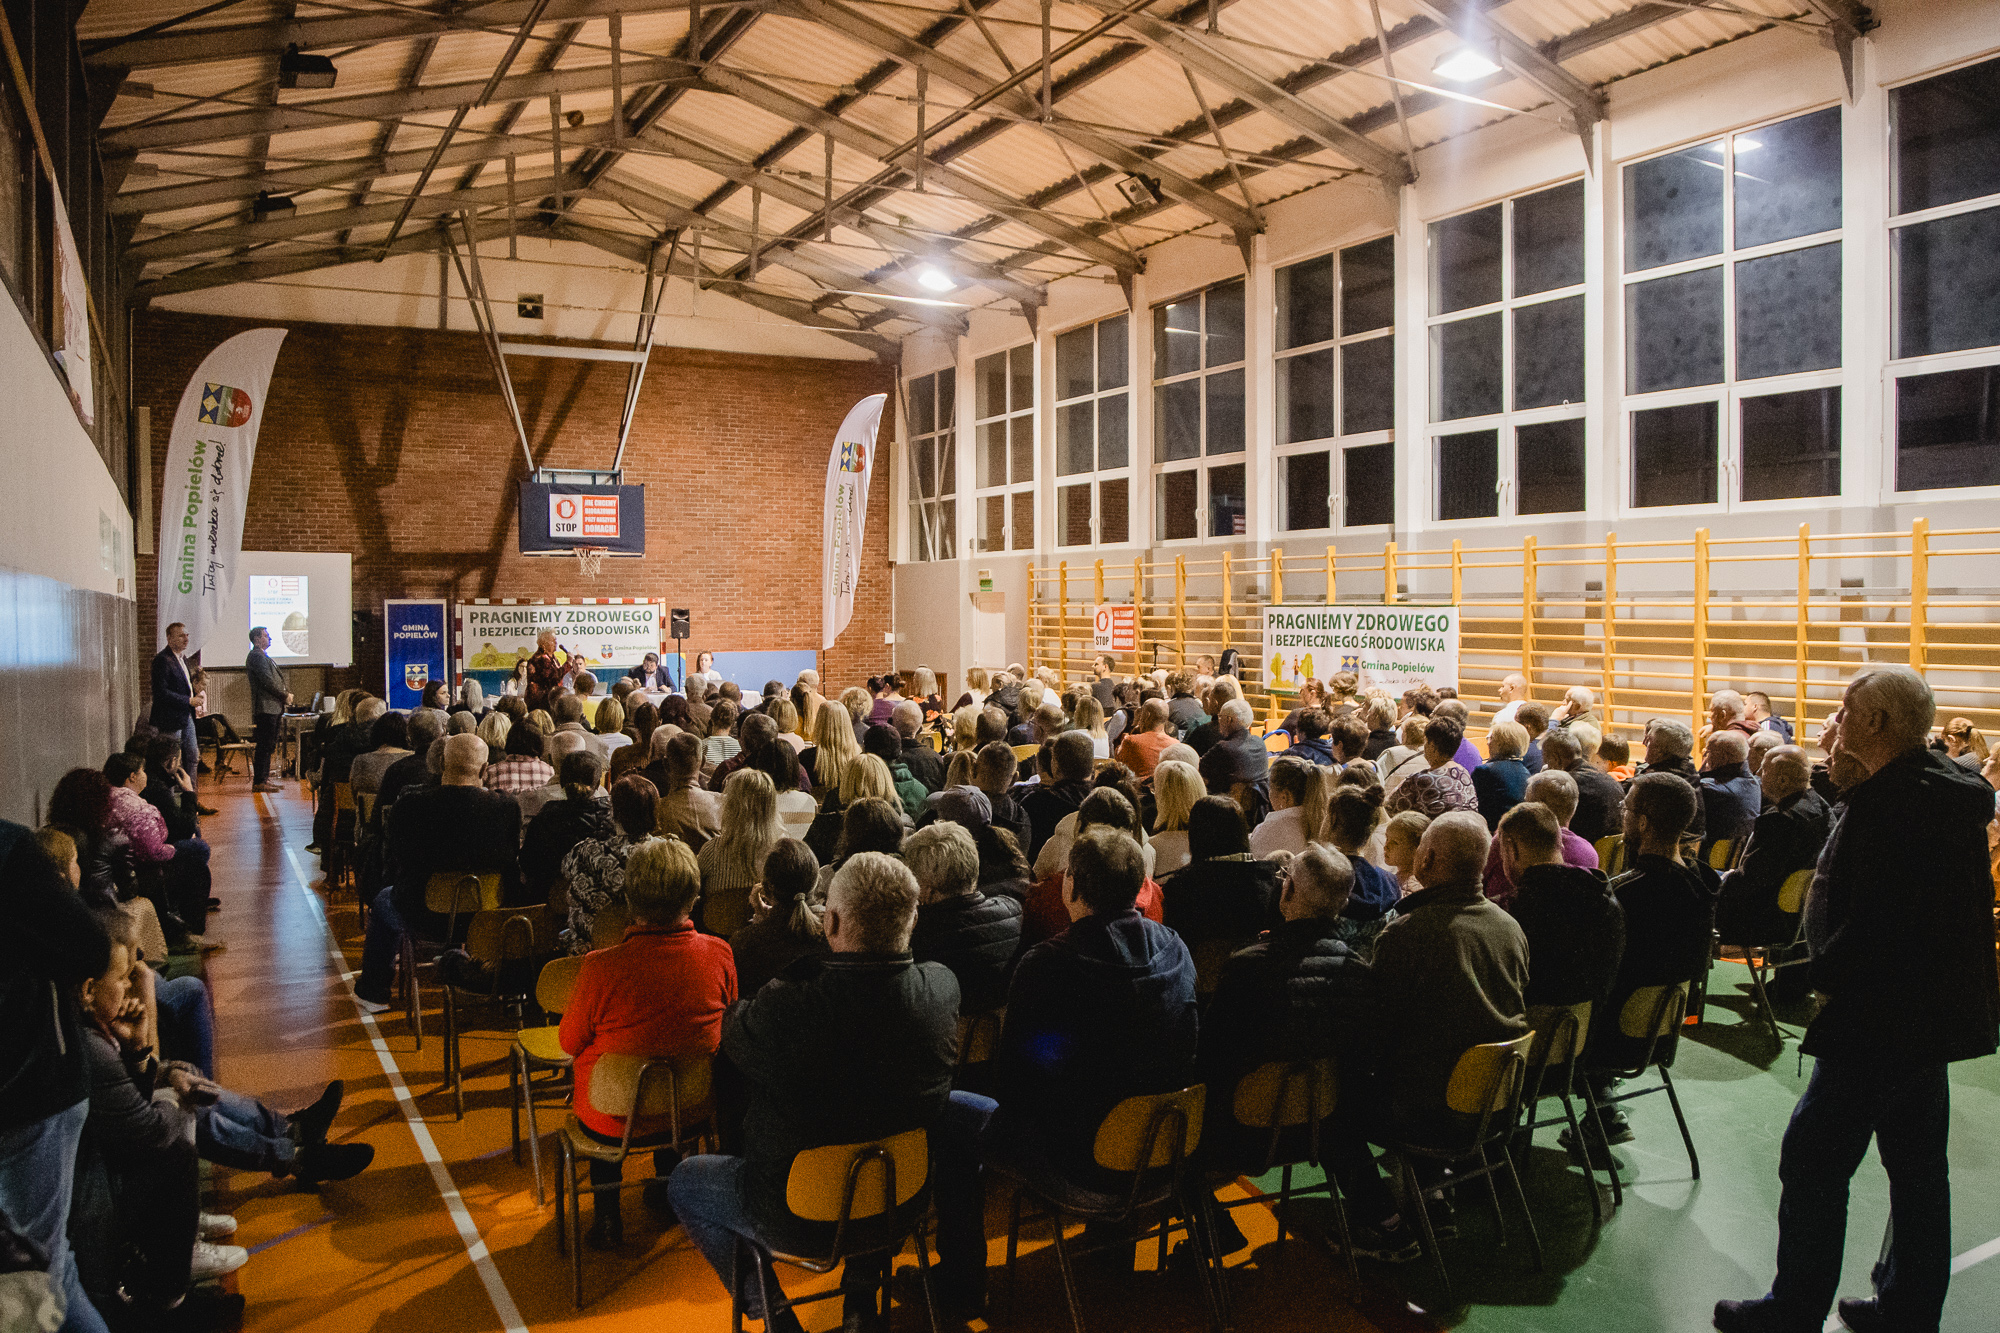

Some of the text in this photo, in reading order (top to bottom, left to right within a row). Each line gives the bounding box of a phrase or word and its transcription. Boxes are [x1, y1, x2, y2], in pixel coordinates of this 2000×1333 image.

[178, 440, 207, 594] Gmina Popielów
[555, 522, 577, 532] STOP
[202, 559, 224, 596] Tutaj
[470, 610, 653, 624] PRAGNIEMY ZDROWEGO
[1268, 613, 1450, 632] PRAGNIEMY ZDROWEGO
[393, 631, 438, 639] POPIELÓW
[473, 627, 477, 637] I
[572, 624, 650, 635] ŚRODOWISKA
[1095, 636, 1110, 645] STOP
[1270, 633, 1445, 652] I BEZPIECZNEGO ŚRODOWISKA
[1361, 660, 1435, 674] Gmina Popielów
